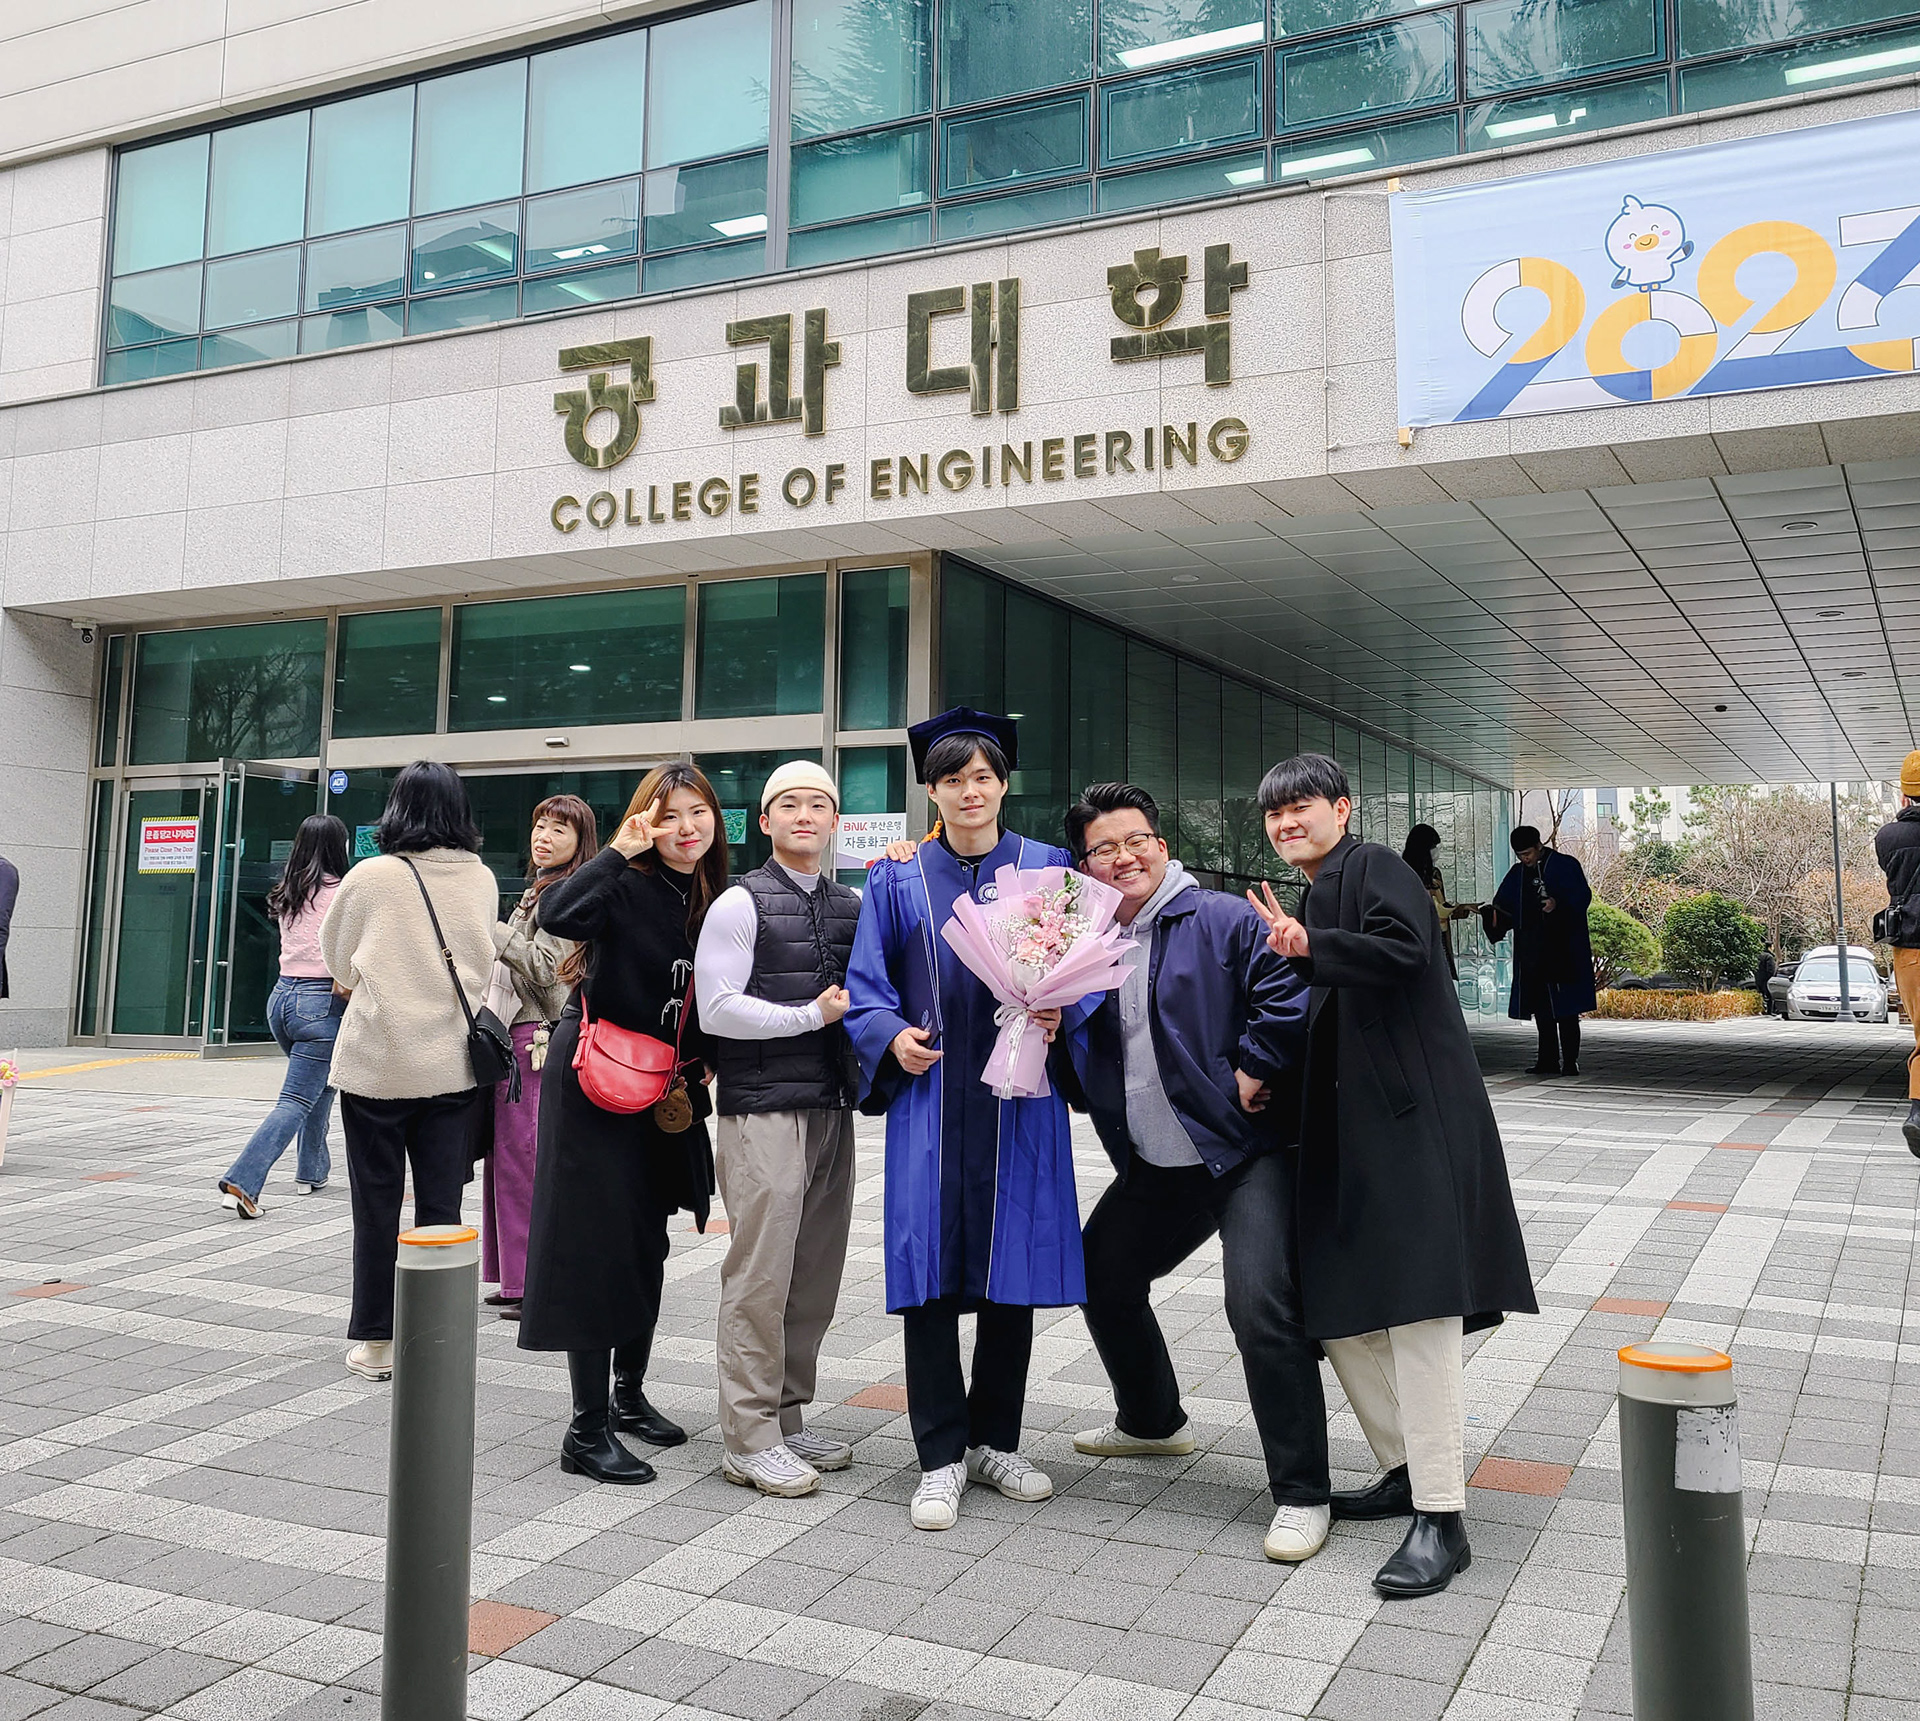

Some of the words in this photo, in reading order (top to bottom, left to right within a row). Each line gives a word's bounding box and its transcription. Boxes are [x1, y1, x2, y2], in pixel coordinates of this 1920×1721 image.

[553, 241, 1249, 469] 공과대학
[550, 472, 759, 533] COLLEGE
[782, 463, 846, 507] OF
[870, 416, 1250, 498] ENGINEERING
[843, 822, 868, 831] BNK
[869, 820, 902, 831] 부산은행
